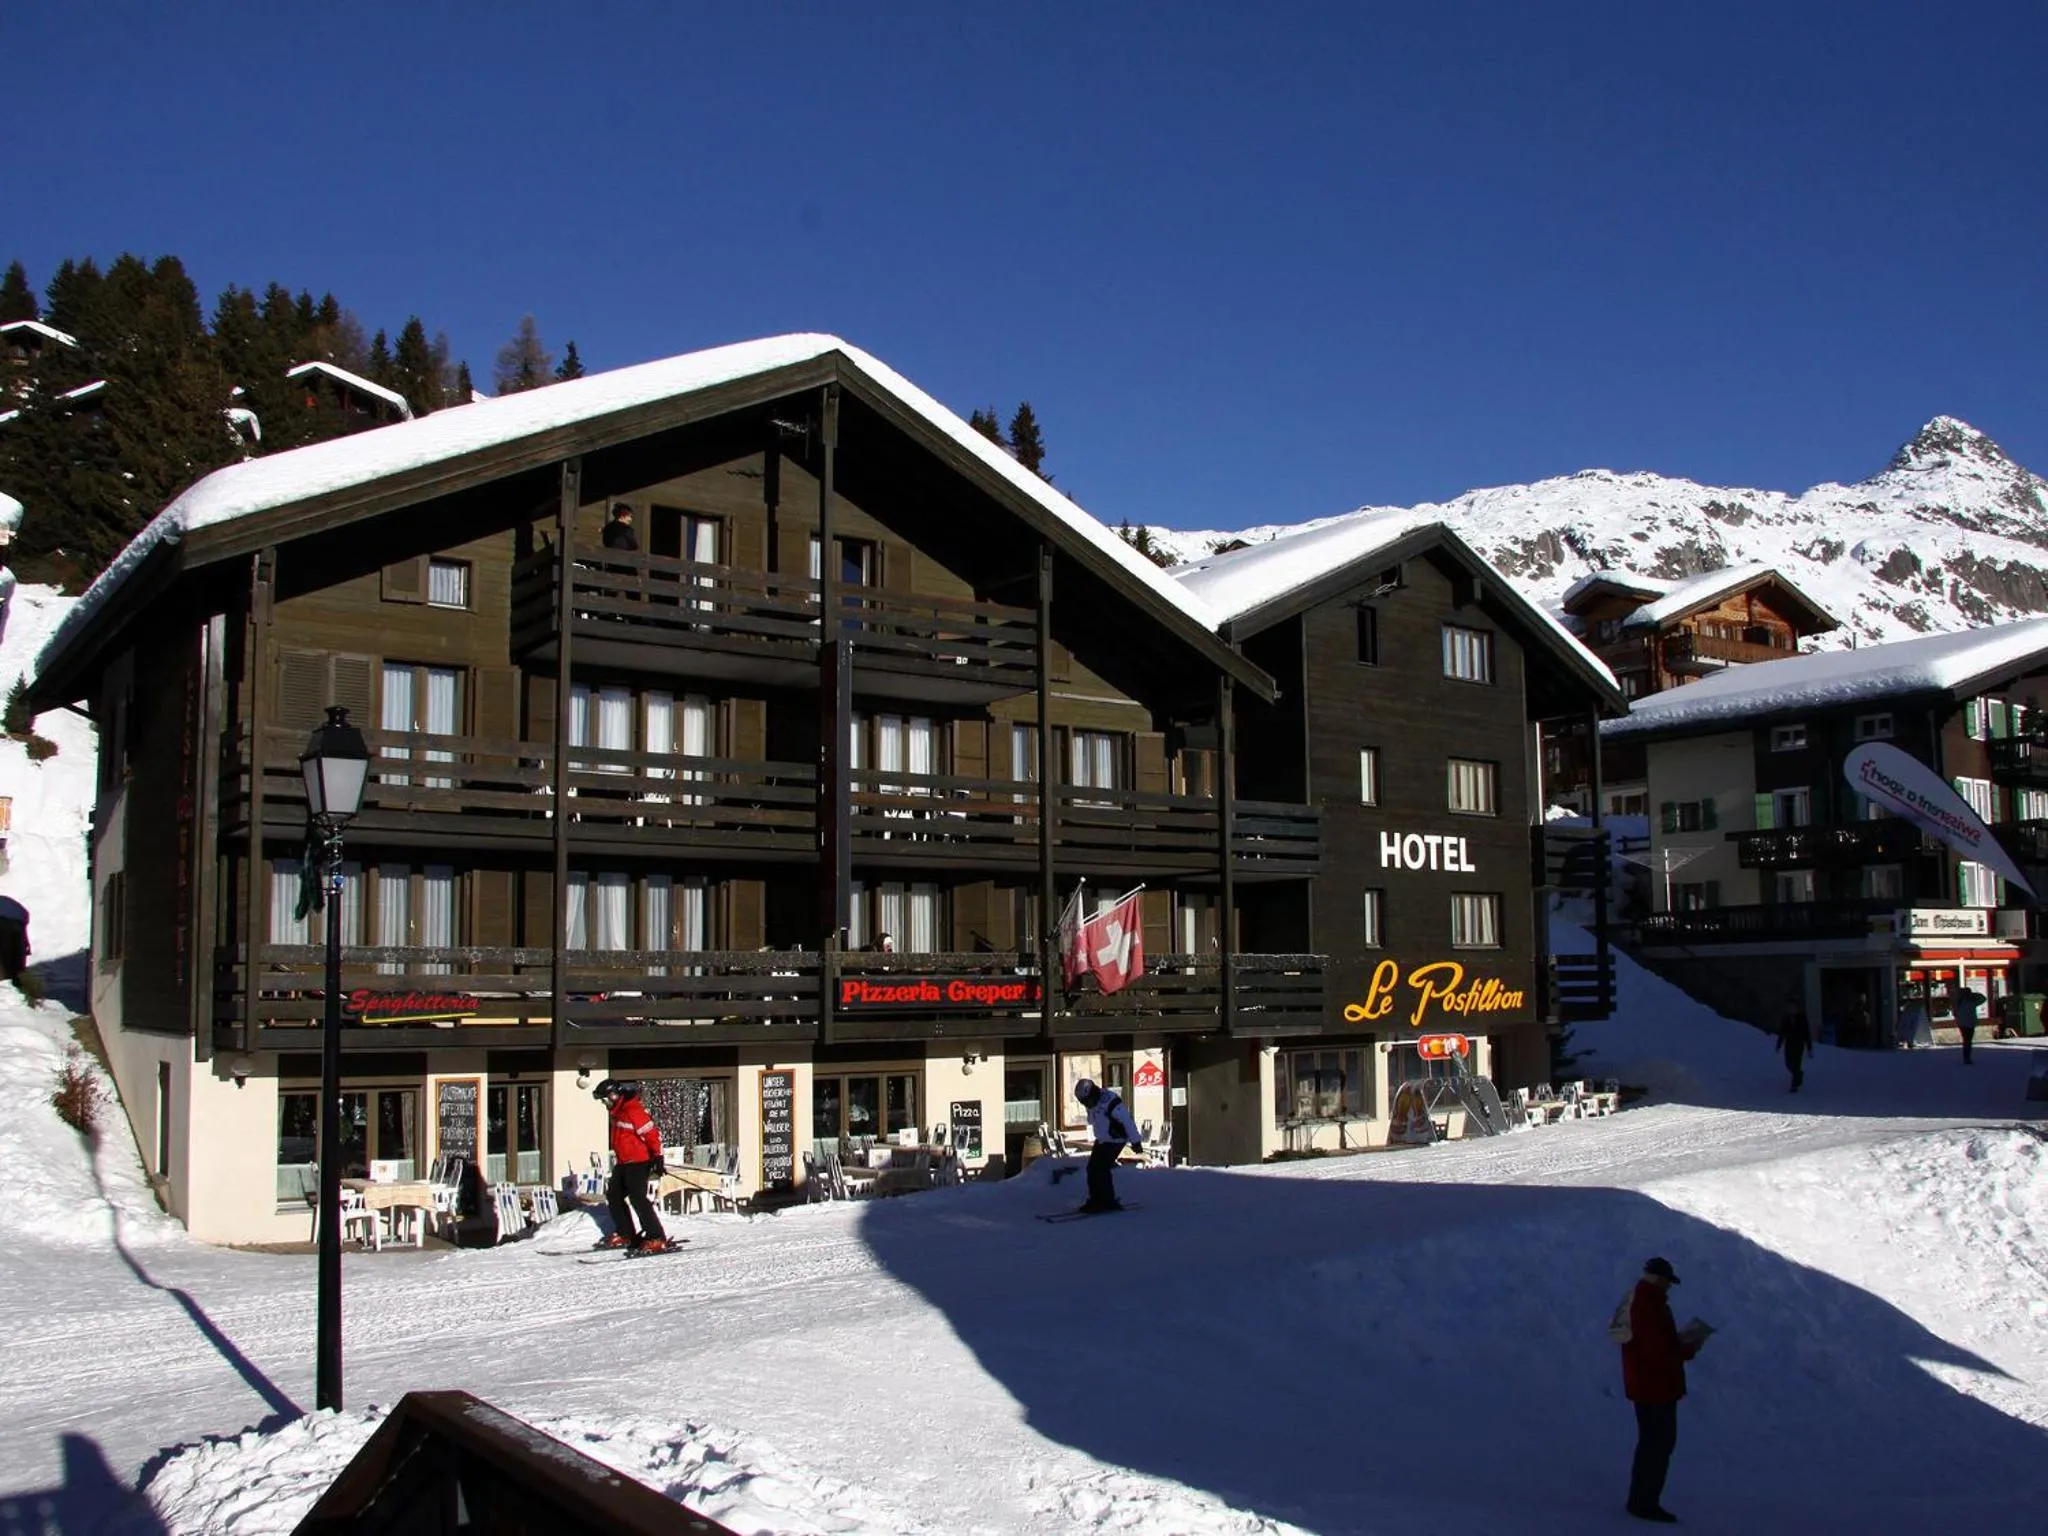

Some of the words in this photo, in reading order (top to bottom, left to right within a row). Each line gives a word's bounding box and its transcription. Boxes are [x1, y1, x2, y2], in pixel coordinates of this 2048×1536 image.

[1380, 831, 1476, 872] HOTEL
[345, 989, 481, 1015] Spaghetteria
[1344, 960, 1399, 1022] Le
[1408, 961, 1523, 1026] Postillion
[952, 1103, 981, 1118] Pizza
